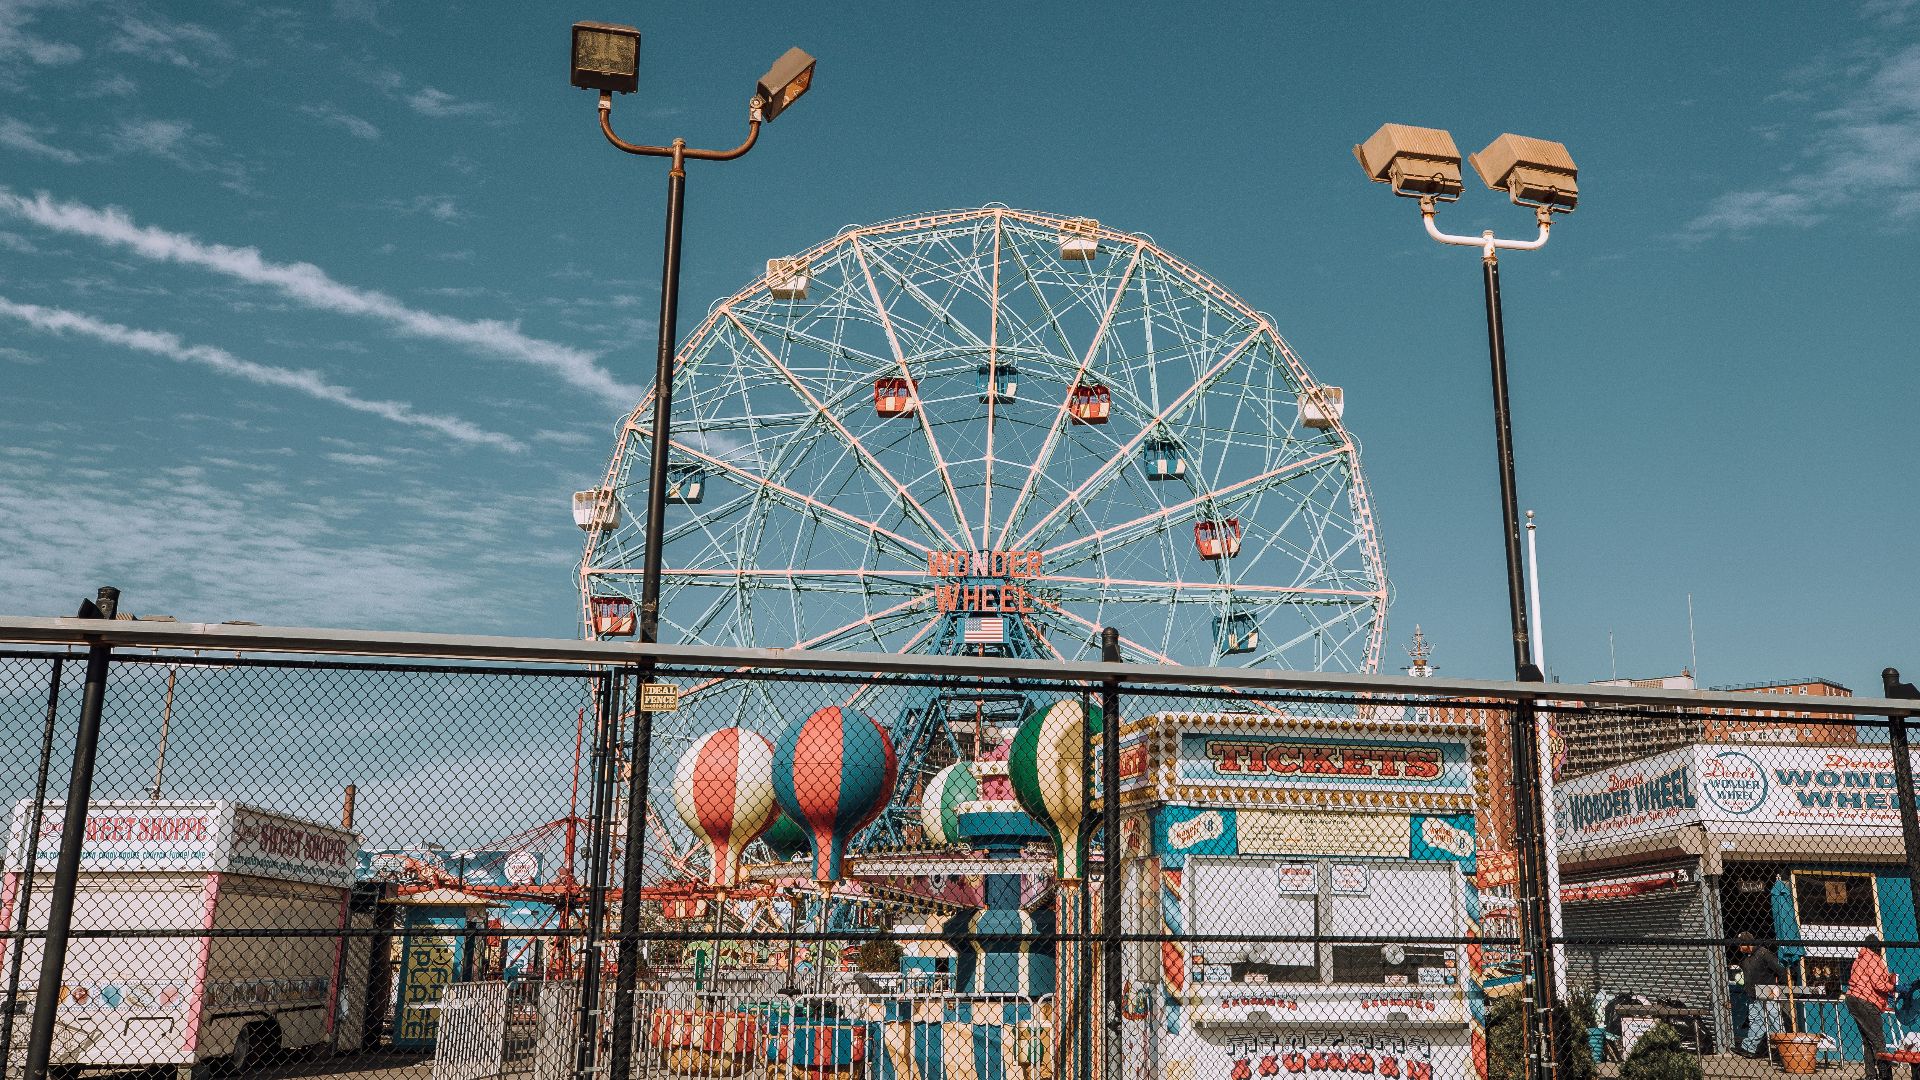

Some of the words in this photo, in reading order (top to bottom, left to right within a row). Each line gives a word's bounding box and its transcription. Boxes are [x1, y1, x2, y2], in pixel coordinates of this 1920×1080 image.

[927, 550, 1044, 577] WONDER
[934, 583, 1034, 612] WHEEL
[644, 686, 676, 695] IDEAL
[644, 695, 676, 704] FENCE
[1212, 744, 1439, 778] TICKETS
[1704, 759, 1755, 778] Deno's
[1608, 772, 1644, 792] Deno's
[1709, 780, 1760, 789] WONDER
[1568, 789, 1632, 832] WONDER
[1635, 765, 1697, 812] WHEEL
[84, 816, 138, 842] WEET
[138, 816, 209, 842] SHOPPE
